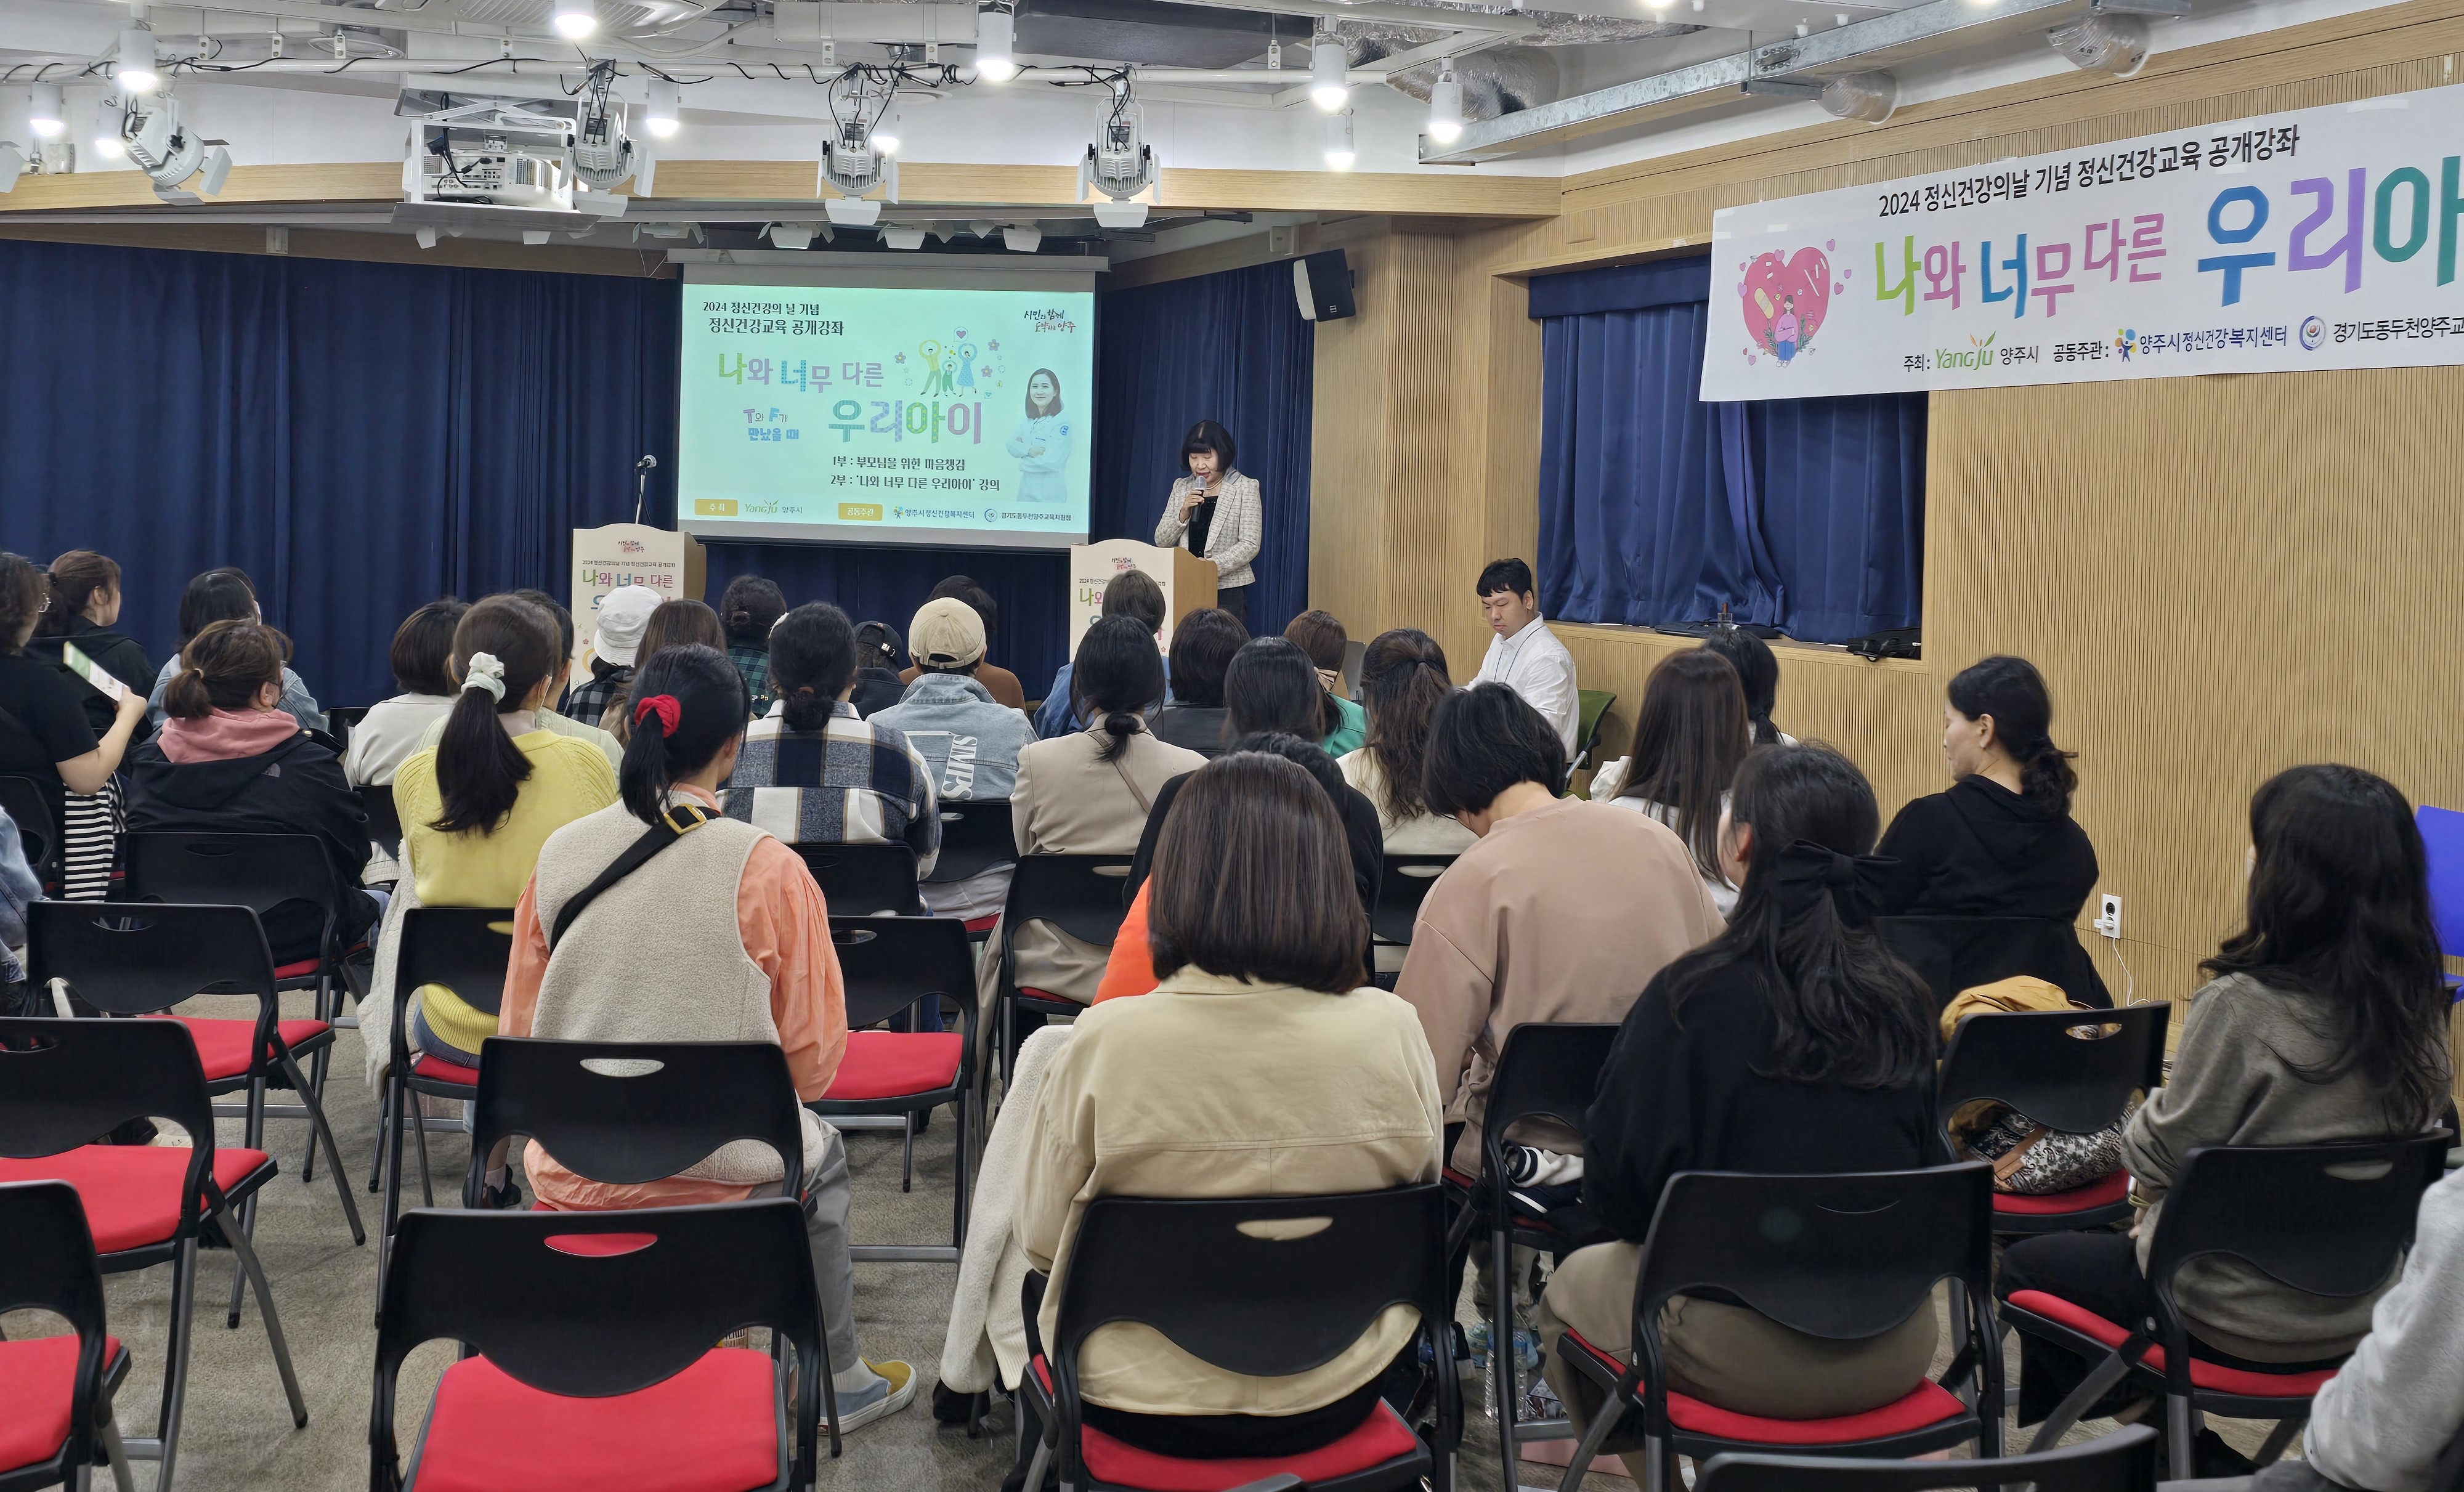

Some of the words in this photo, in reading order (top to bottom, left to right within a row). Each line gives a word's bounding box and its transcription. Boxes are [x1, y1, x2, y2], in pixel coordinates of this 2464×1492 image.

[1878, 190, 1921, 217] 2024
[1924, 169, 2030, 212] 정신건강의날
[2035, 161, 2072, 194] 기념
[2077, 140, 2202, 189] 정신건강교육
[2208, 124, 2301, 168] 공개강좌
[1874, 235, 1966, 316] 나와
[1981, 233, 2075, 319] 너무
[2083, 213, 2167, 283] 다른
[703, 301, 727, 312] 2024
[731, 302, 782, 315] 정신건강의
[800, 304, 820, 315] 기념
[708, 317, 787, 334] 정신건강교육
[792, 320, 845, 336] 공개강좌
[2000, 345, 2040, 365] 양주시
[2139, 325, 2288, 355] 양주시정신건강복지센터
[719, 353, 774, 385] 나와
[781, 360, 833, 394] 너무
[842, 362, 884, 387] 다른
[743, 408, 764, 424] T와
[829, 399, 982, 444] 우리아이
[748, 428, 782, 442] 만났을
[832, 456, 847, 467] 1부
[857, 456, 897, 469] 부모님을
[901, 458, 921, 470] 위한
[925, 458, 965, 471] 마음챙김
[830, 475, 846, 486] 2부
[883, 476, 904, 489] 너무
[907, 477, 928, 489] 다른
[979, 479, 1000, 492] 강의
[583, 569, 613, 587] 나와
[650, 574, 673, 588] 다른
